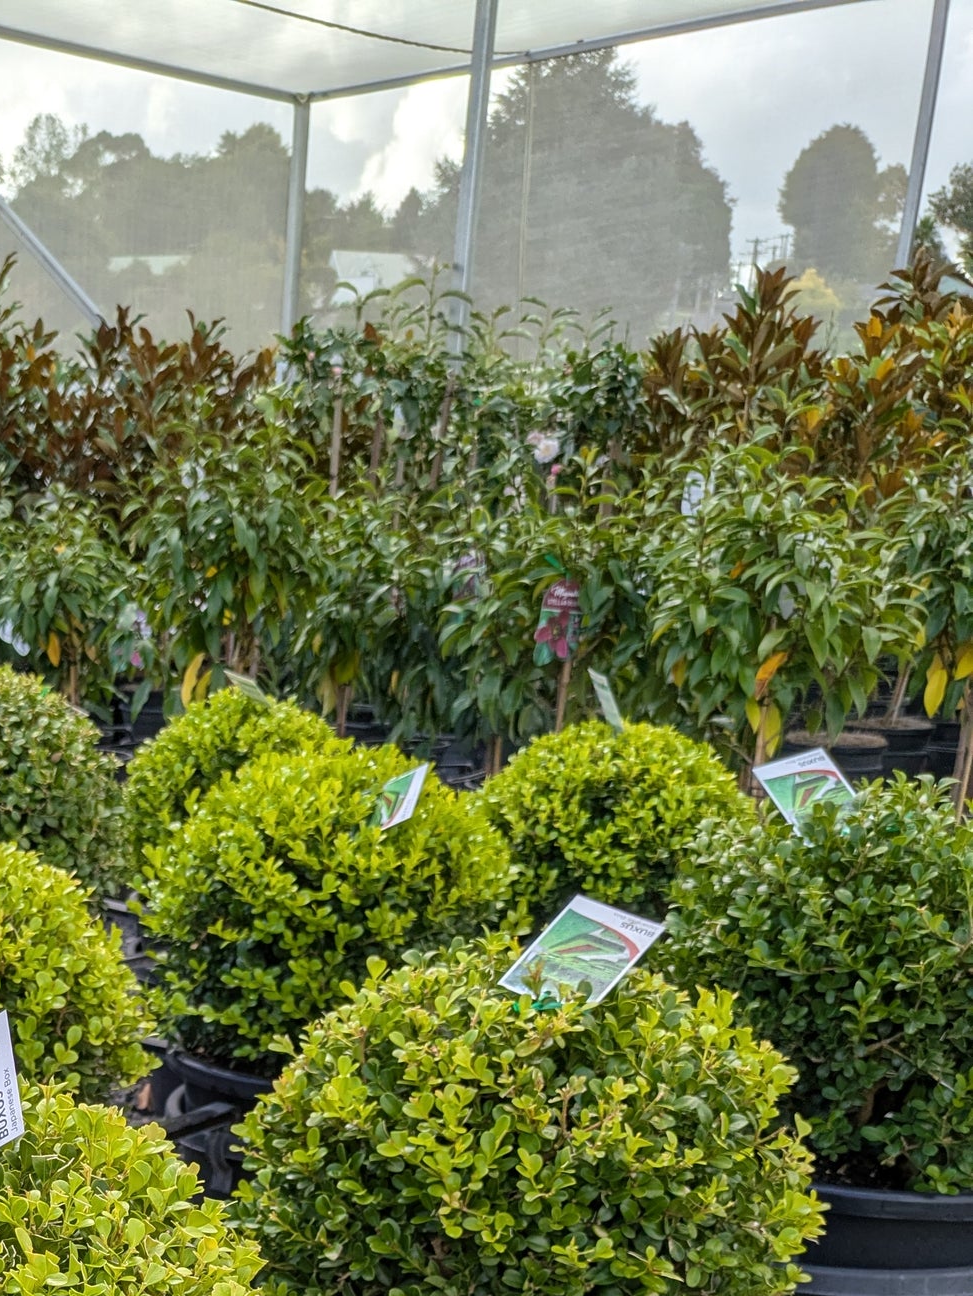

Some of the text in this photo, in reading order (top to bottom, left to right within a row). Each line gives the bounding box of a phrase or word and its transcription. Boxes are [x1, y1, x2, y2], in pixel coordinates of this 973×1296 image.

[620, 921, 655, 938] BUXUS
[3, 1067, 19, 1134] Japanese Box
